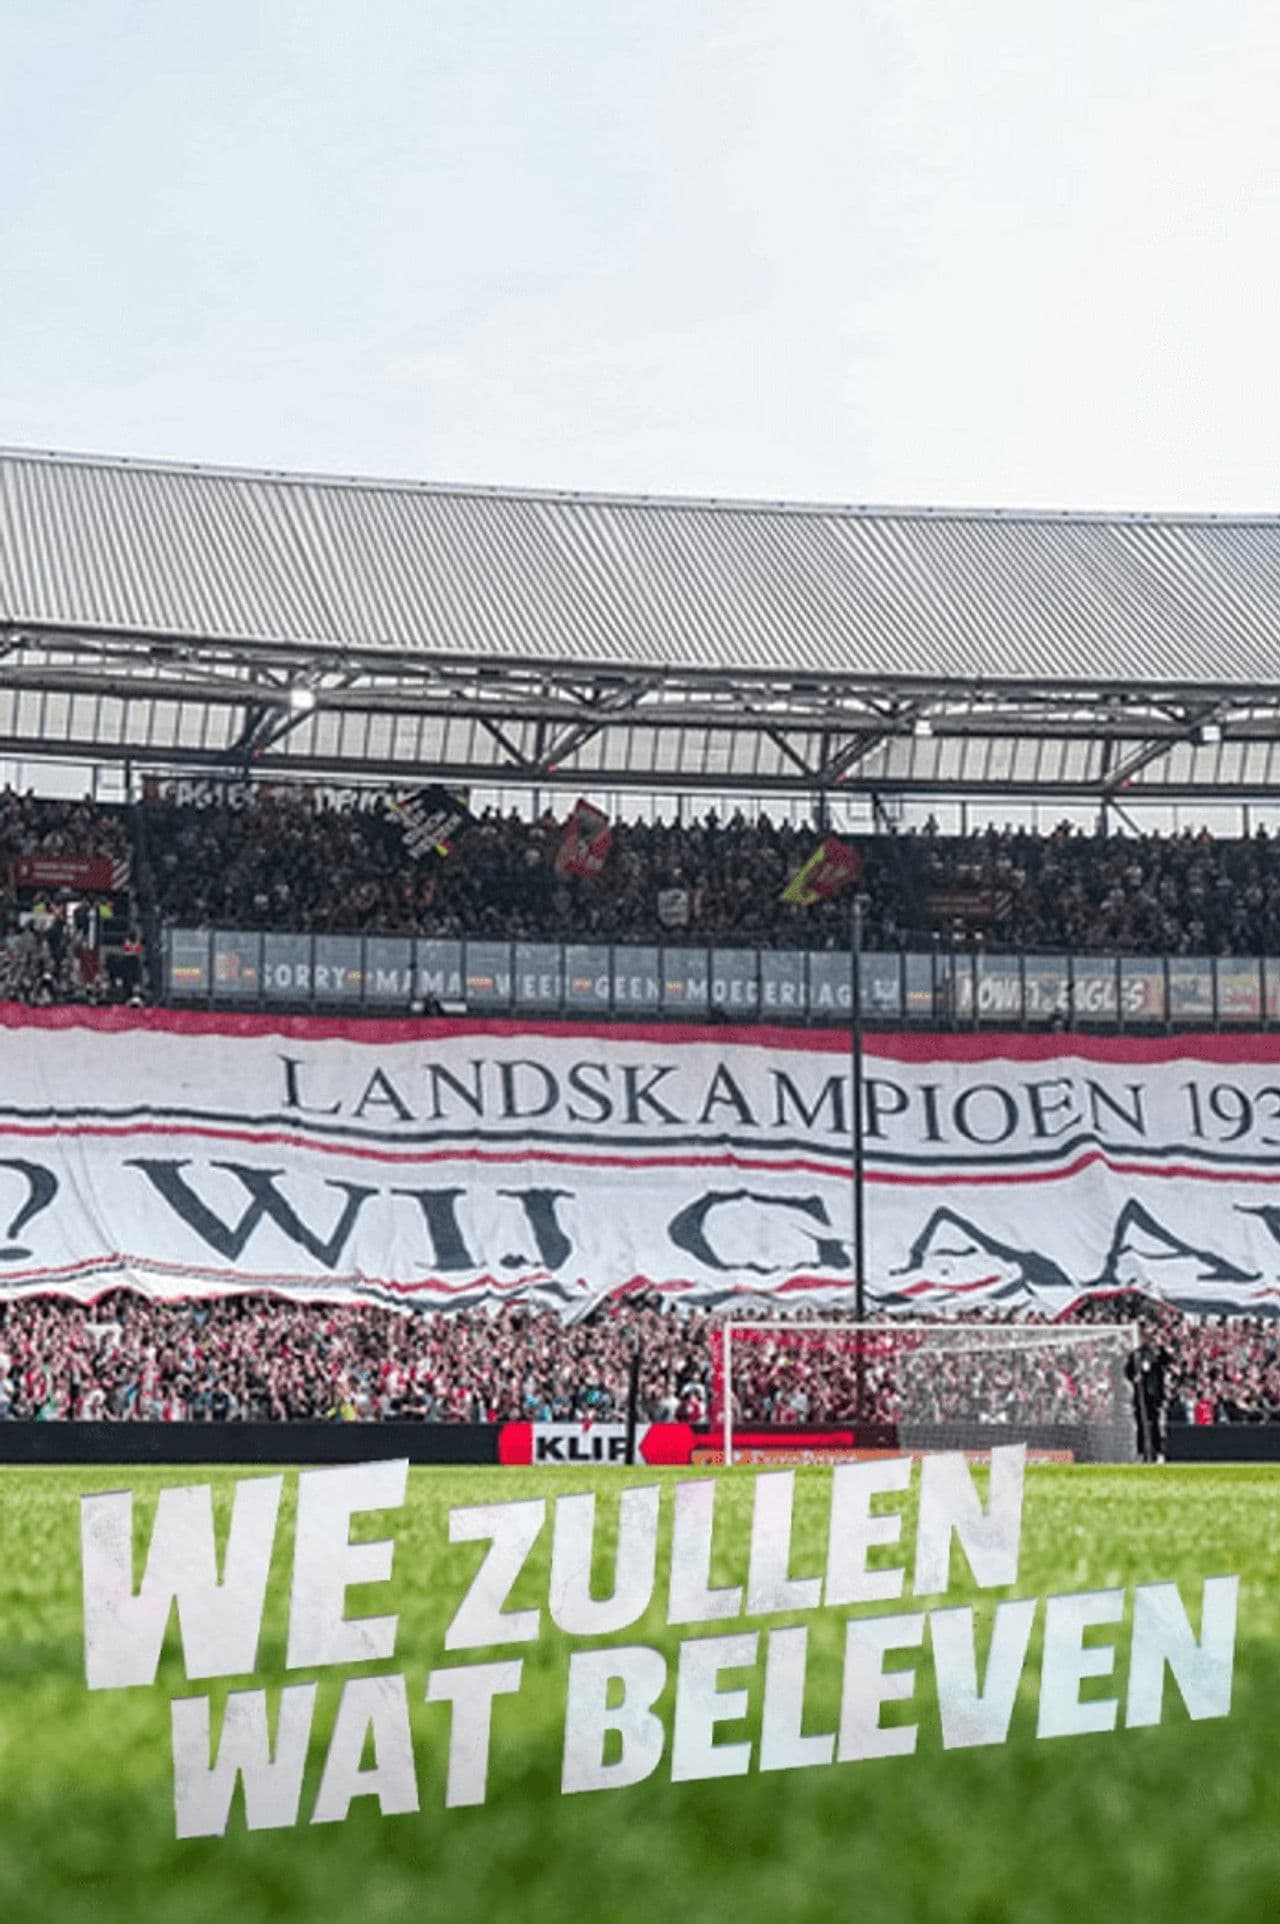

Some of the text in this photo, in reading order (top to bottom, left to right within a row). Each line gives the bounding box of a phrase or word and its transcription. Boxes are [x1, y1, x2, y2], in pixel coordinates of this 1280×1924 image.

[278, 1054, 1147, 1144] LANDSKAMPIOEN
[123, 1157, 576, 1271] WIJ
[667, 1188, 1280, 1287] GAA
